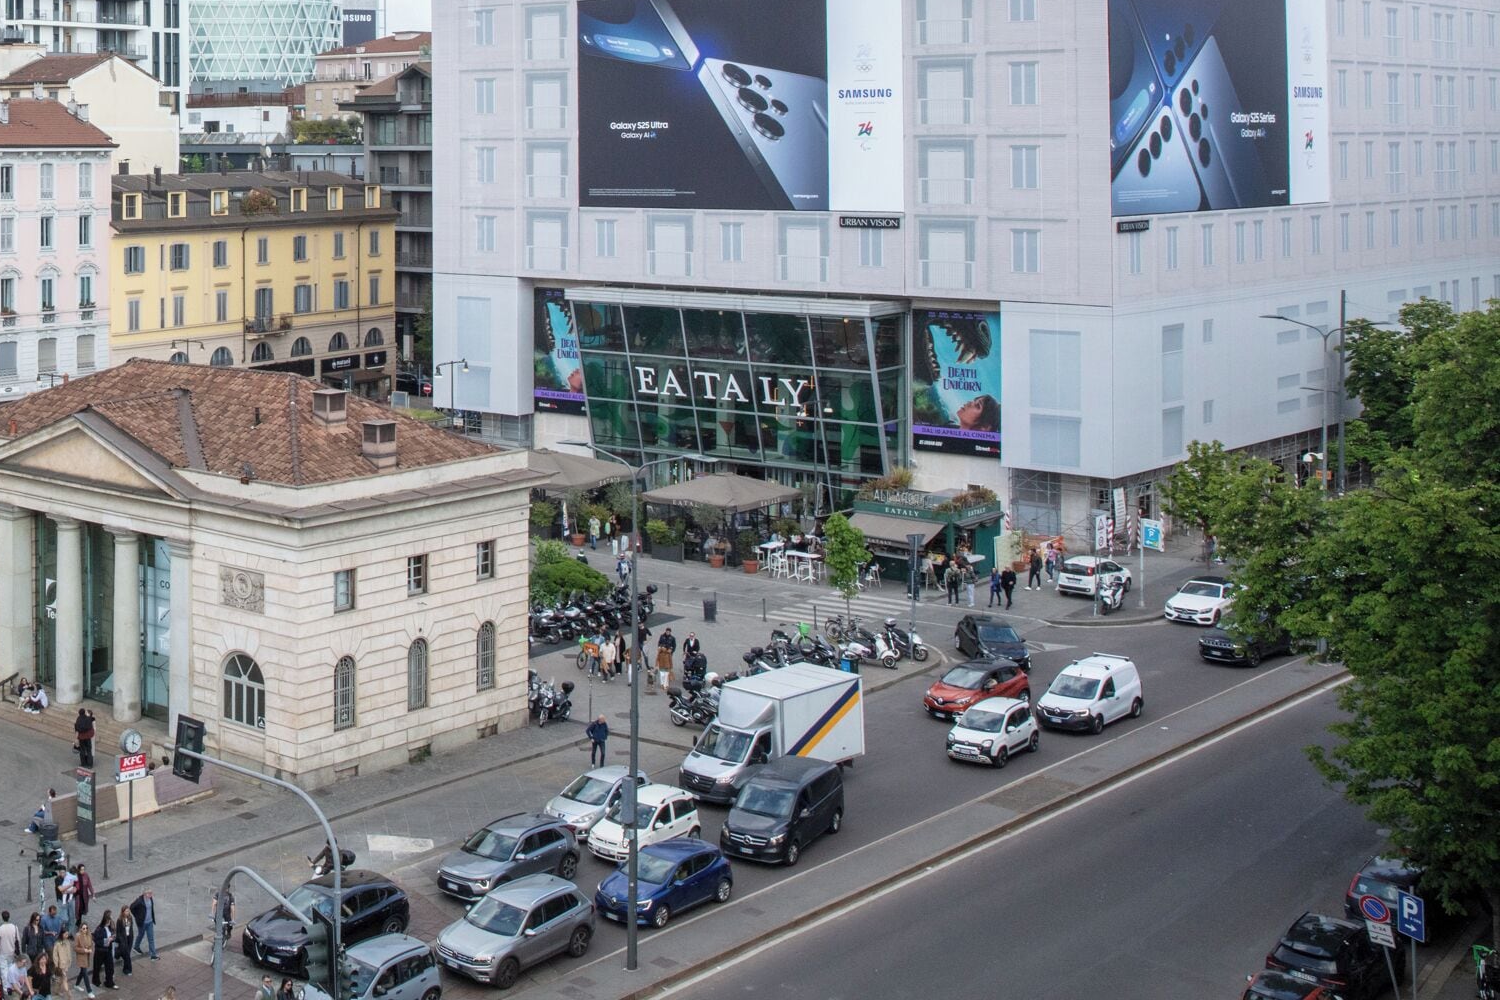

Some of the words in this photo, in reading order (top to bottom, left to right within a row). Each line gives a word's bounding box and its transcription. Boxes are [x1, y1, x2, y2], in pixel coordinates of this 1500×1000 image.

[838, 88, 892, 99] SAMSUNG
[1293, 86, 1323, 98] SAMSUNG
[1231, 112, 1249, 126] Galaxy
[1250, 112, 1259, 122] S25
[1259, 112, 1275, 123] Series
[610, 121, 637, 130] Galaxy
[637, 121, 650, 129] S25
[650, 121, 668, 129] Ultra
[621, 131, 643, 140] Galaxy
[1241, 128, 1255, 139] Galaxy
[840, 218, 868, 227] URBAN
[869, 218, 899, 227] VISION
[948, 366, 976, 378] DEATH
[635, 366, 808, 407] EATALY
[943, 379, 982, 392] UNICORN
[942, 429, 961, 437] APRILE
[971, 431, 996, 440] CINEMA
[672, 499, 699, 508] EATAL
[885, 507, 919, 517] EATALY
[967, 507, 986, 517] EATALY
[122, 754, 143, 767] KFC
[1403, 897, 1418, 919] P
